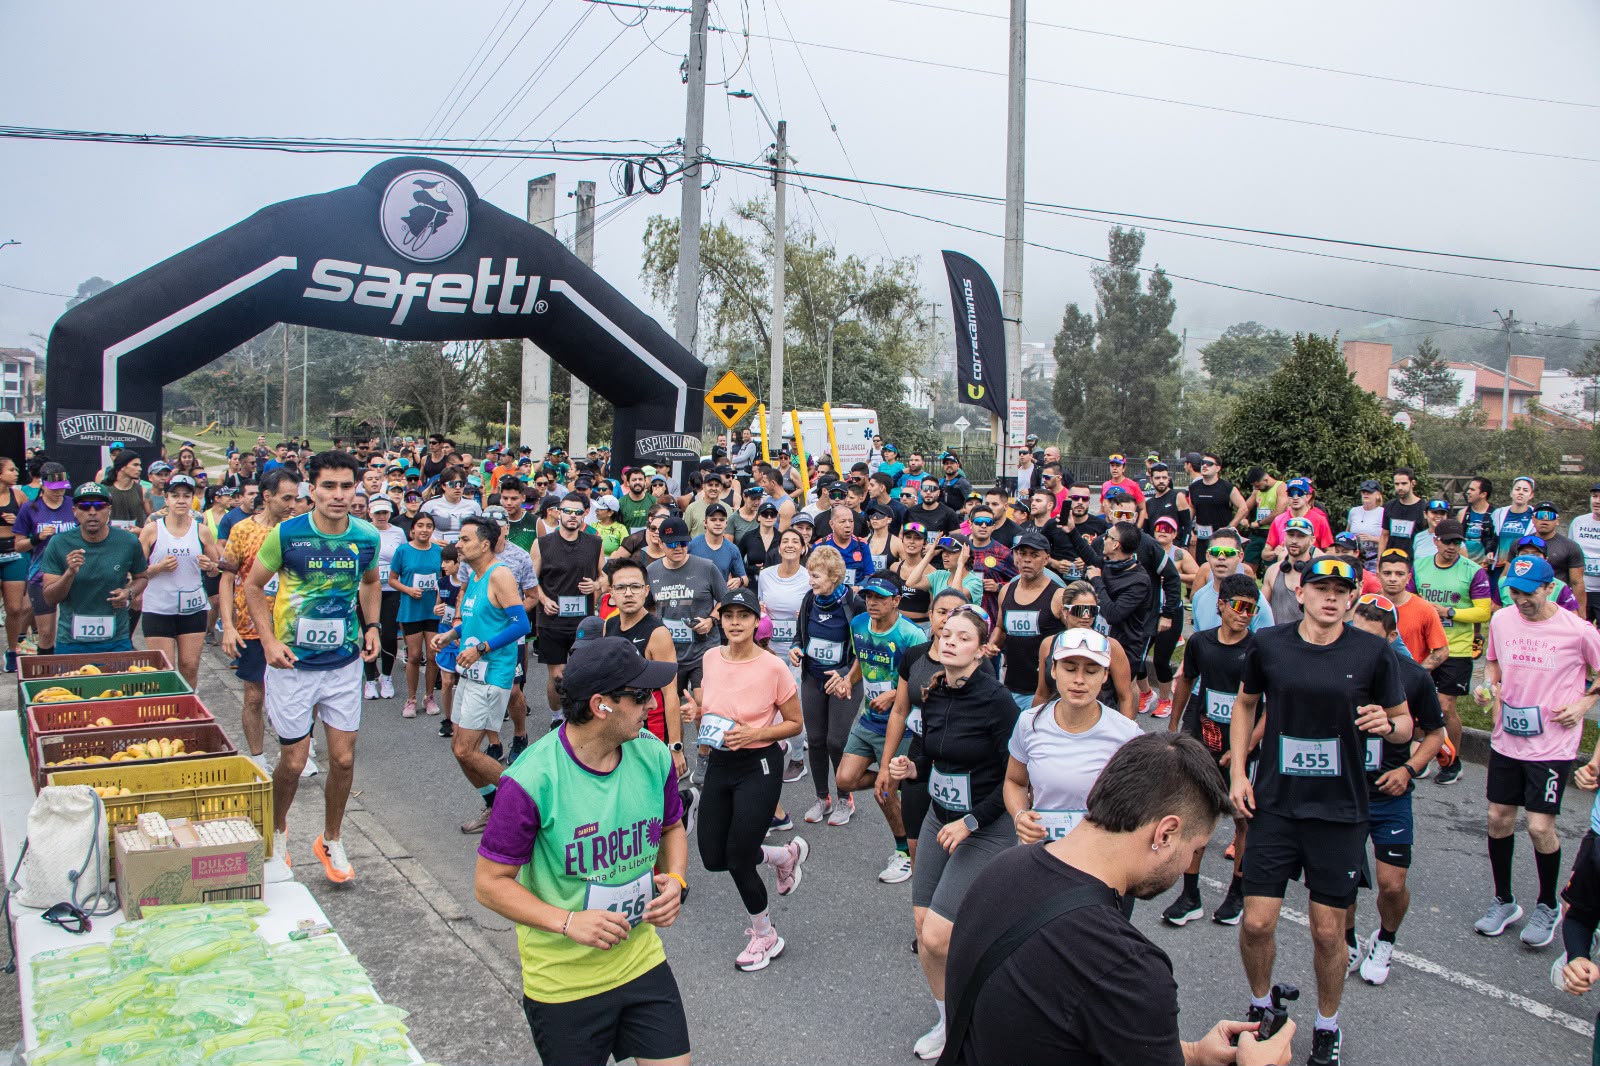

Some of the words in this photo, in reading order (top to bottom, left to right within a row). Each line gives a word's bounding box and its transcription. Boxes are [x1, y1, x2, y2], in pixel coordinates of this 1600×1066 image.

[303, 258, 541, 325] safetti
[963, 278, 983, 381] correcaminos
[62, 416, 115, 439] ESPIRITU
[117, 417, 155, 441] SANTO
[639, 436, 683, 454] ESPIRITU
[1394, 525, 1406, 533] 191
[167, 547, 190, 556] LOVE
[418, 580, 435, 588] 049
[654, 586, 695, 601] MEDELLÍN
[186, 597, 202, 608] 103
[565, 603, 580, 611] 371
[82, 625, 105, 636] 120
[1012, 619, 1030, 631] 160
[306, 629, 338, 644] 026
[772, 627, 793, 638] 054
[813, 646, 833, 660] 130
[1512, 654, 1543, 664] ROSAS
[1213, 703, 1233, 715] 20
[1506, 716, 1528, 730] 169
[1291, 751, 1330, 768] 455
[1545, 768, 1559, 803] DSV
[933, 783, 961, 803] 542
[198, 855, 243, 873] DULCE
[618, 860, 628, 873] la
